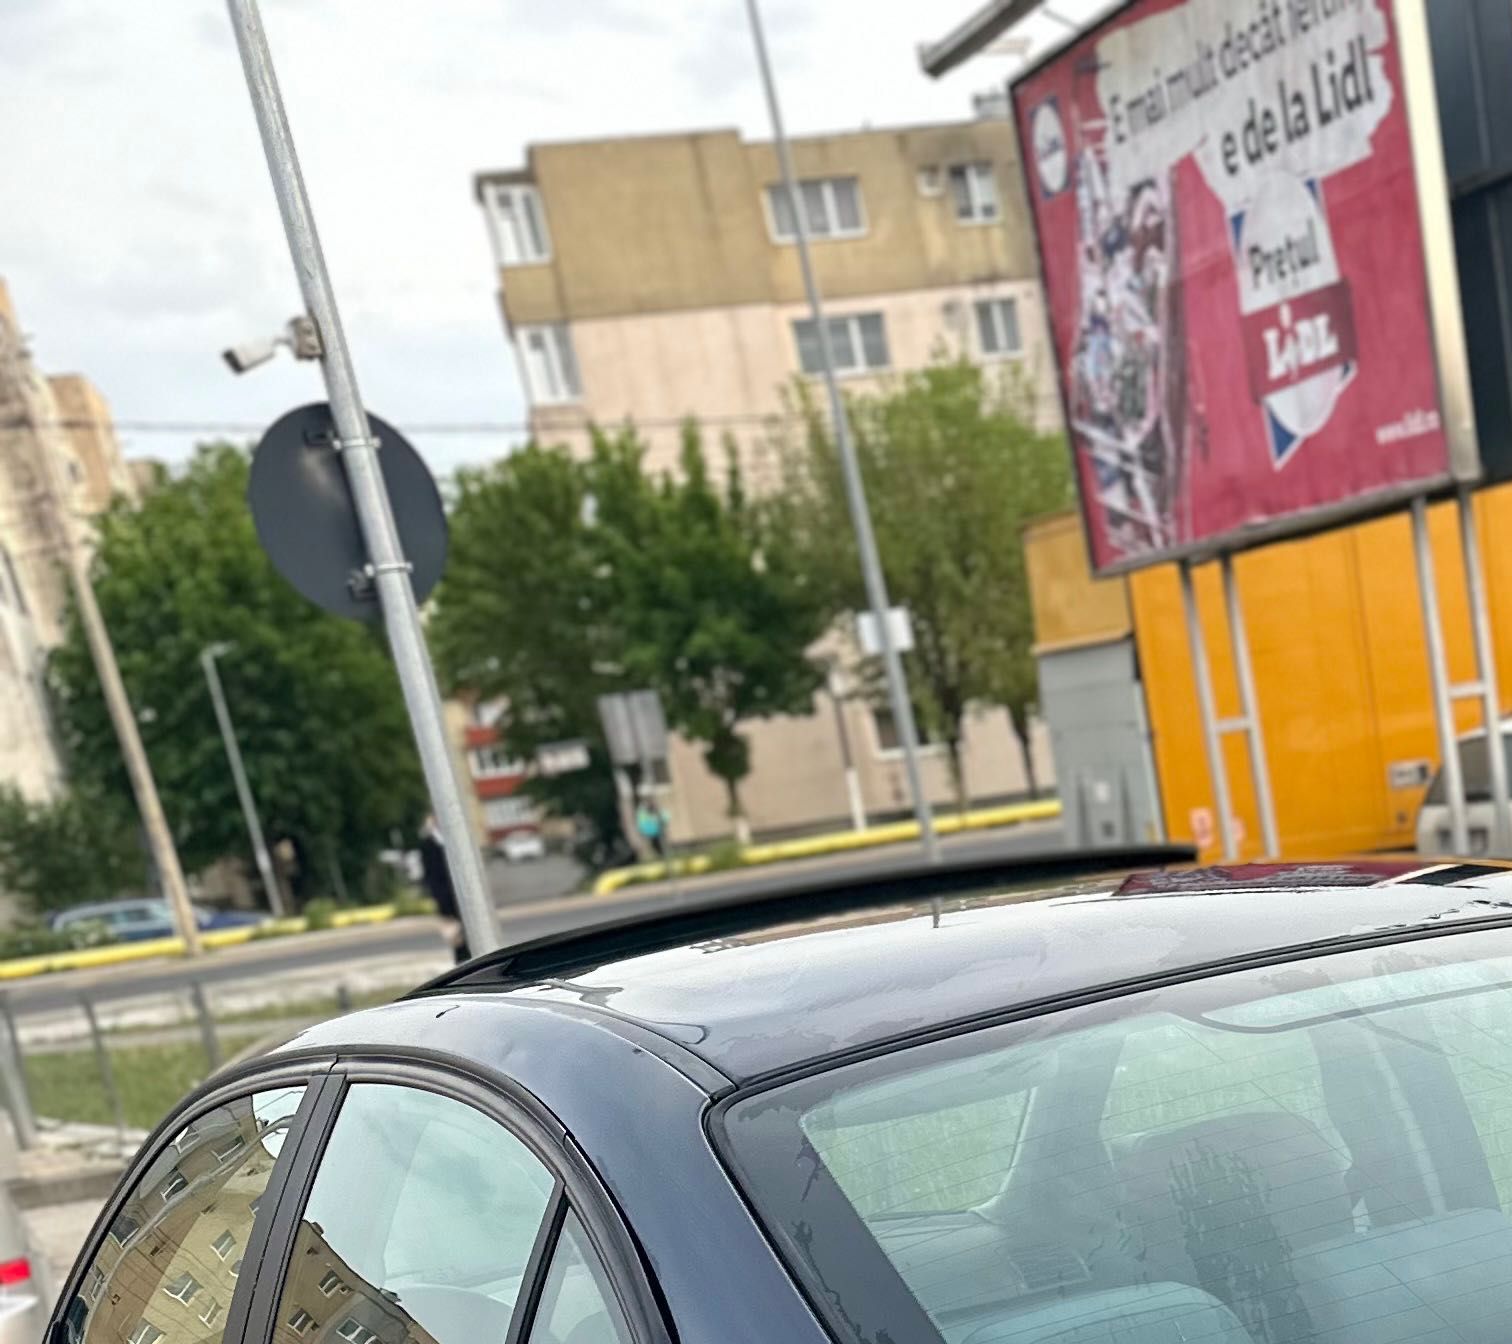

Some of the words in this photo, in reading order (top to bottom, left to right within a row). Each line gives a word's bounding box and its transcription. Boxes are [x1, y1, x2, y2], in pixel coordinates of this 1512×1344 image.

[1110, 93, 1126, 144] E
[1221, 130, 1238, 176] e
[1243, 98, 1278, 165] de
[1278, 79, 1310, 144] la
[1311, 34, 1375, 127] Lidl
